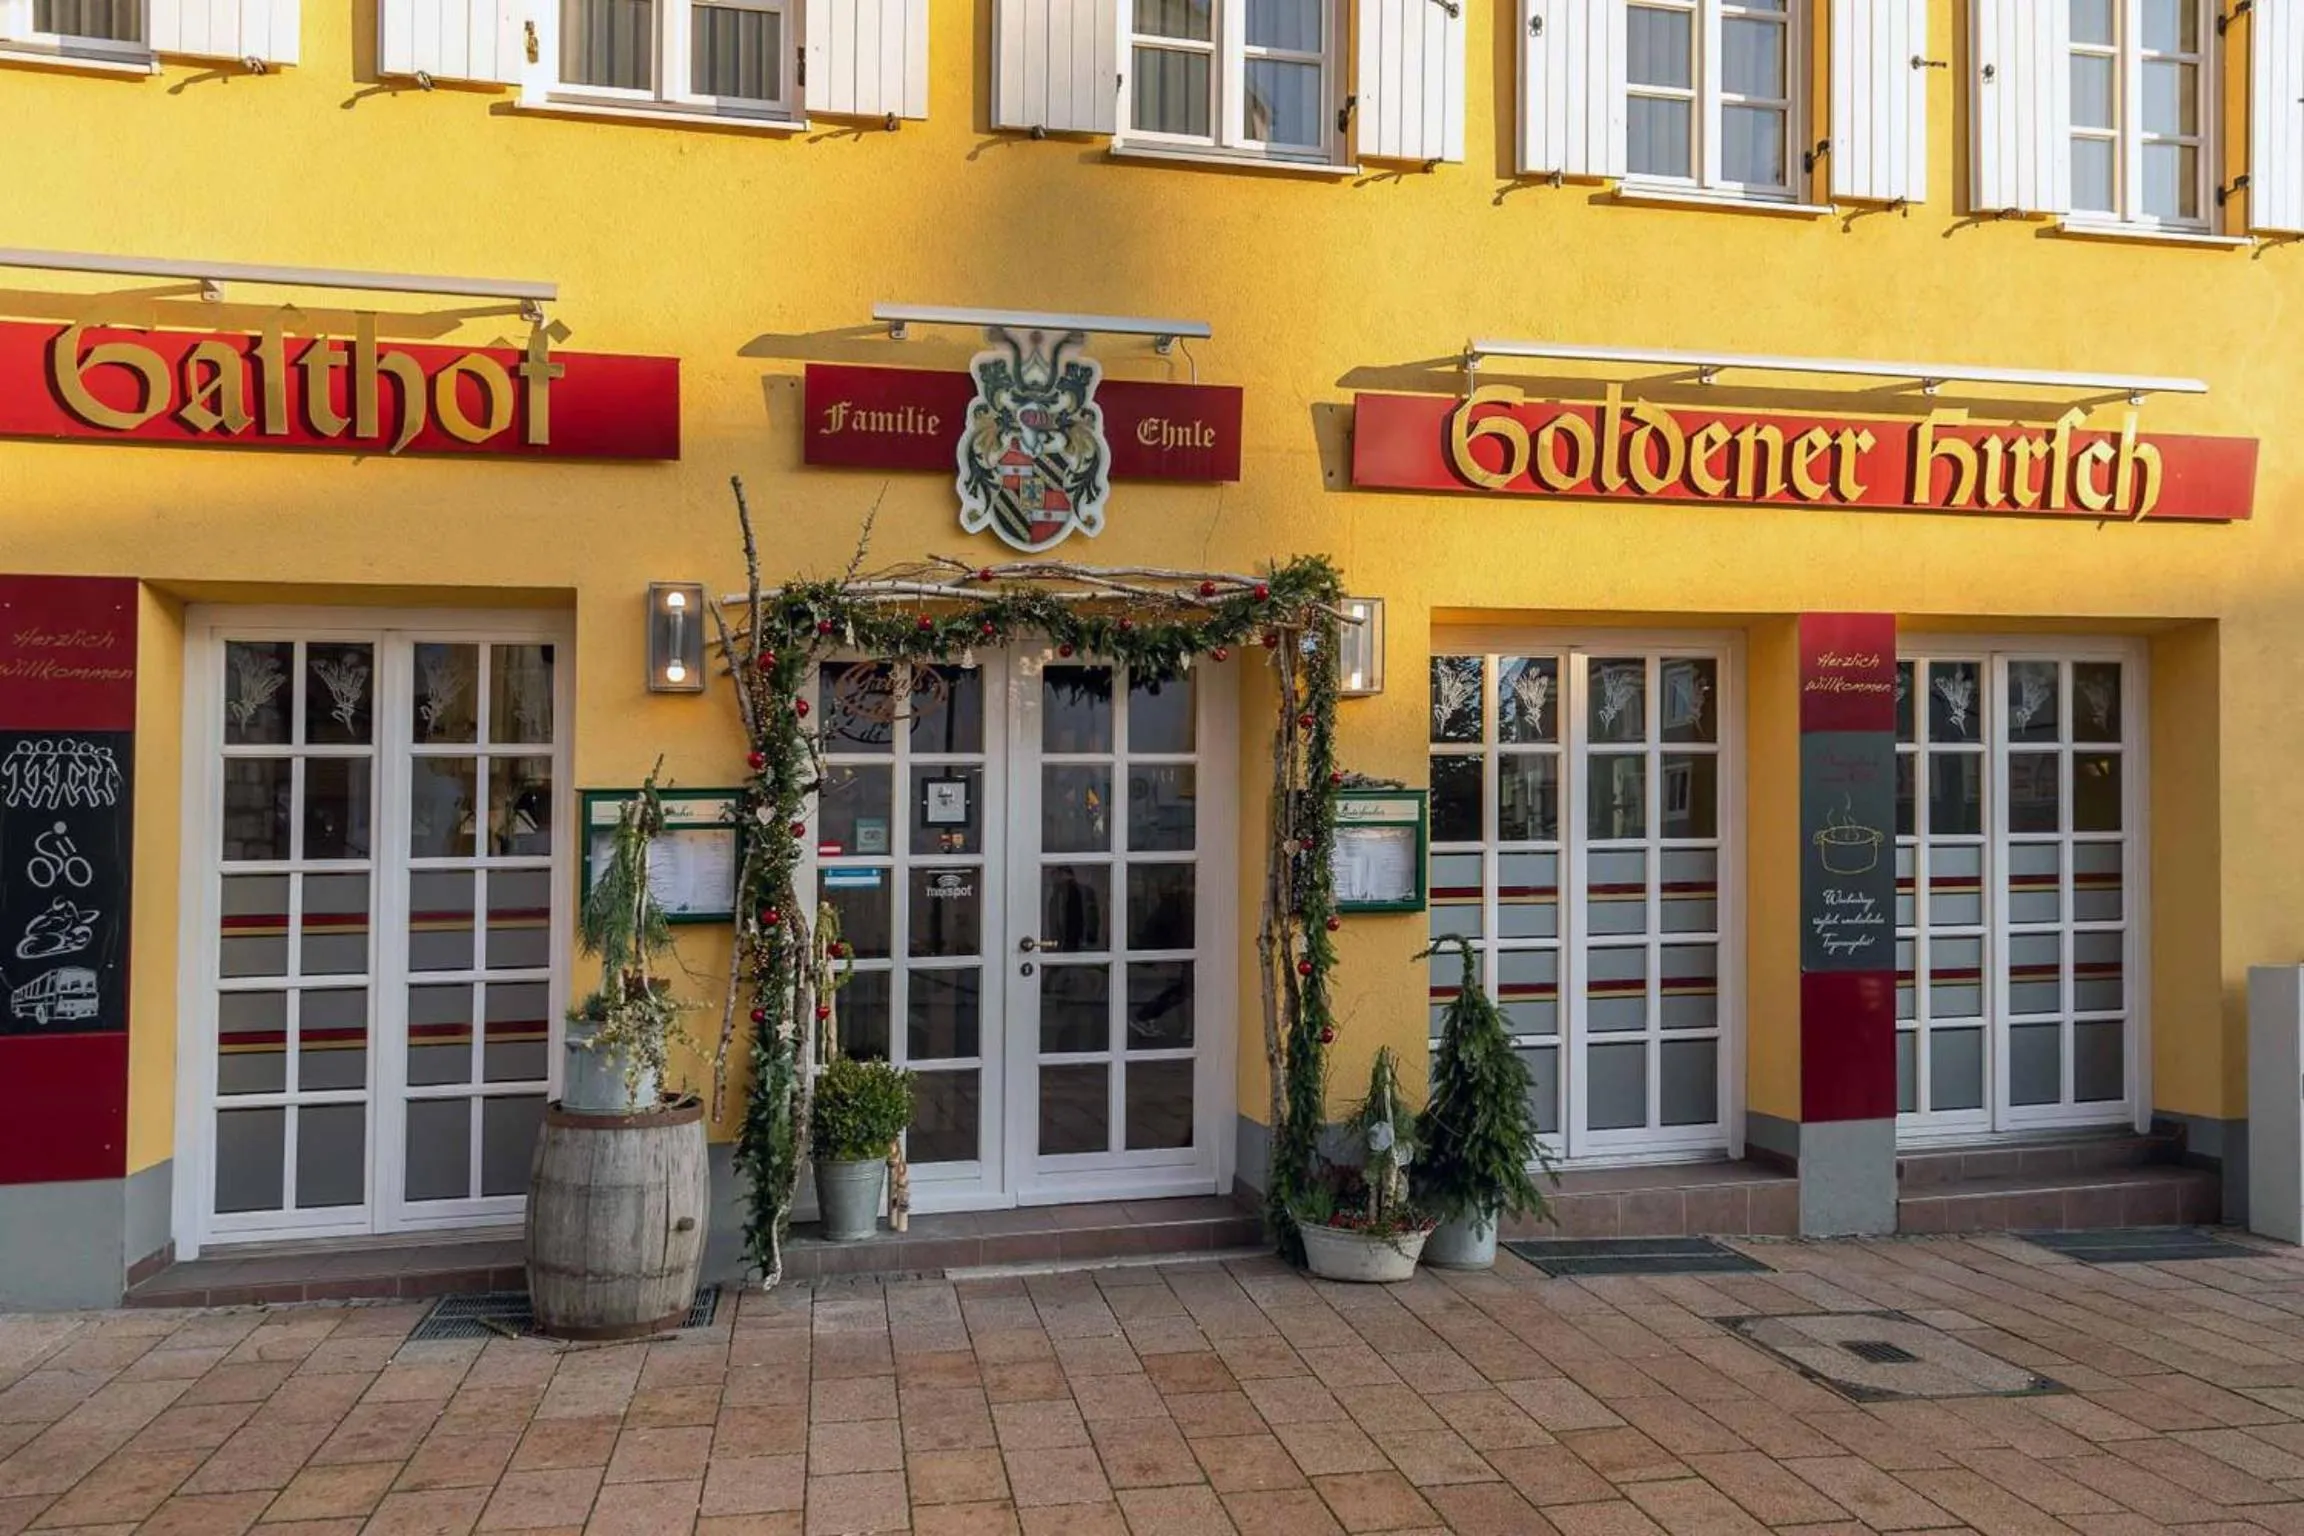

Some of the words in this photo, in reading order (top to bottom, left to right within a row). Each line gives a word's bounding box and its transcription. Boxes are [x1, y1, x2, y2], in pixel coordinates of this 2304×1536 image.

[819, 400, 941, 436] Familie
[1137, 418, 1217, 451] Ehnle
[1451, 383, 1877, 502] Goldener
[12, 627, 116, 649] Herzlich
[1816, 651, 1881, 668] Herzlich
